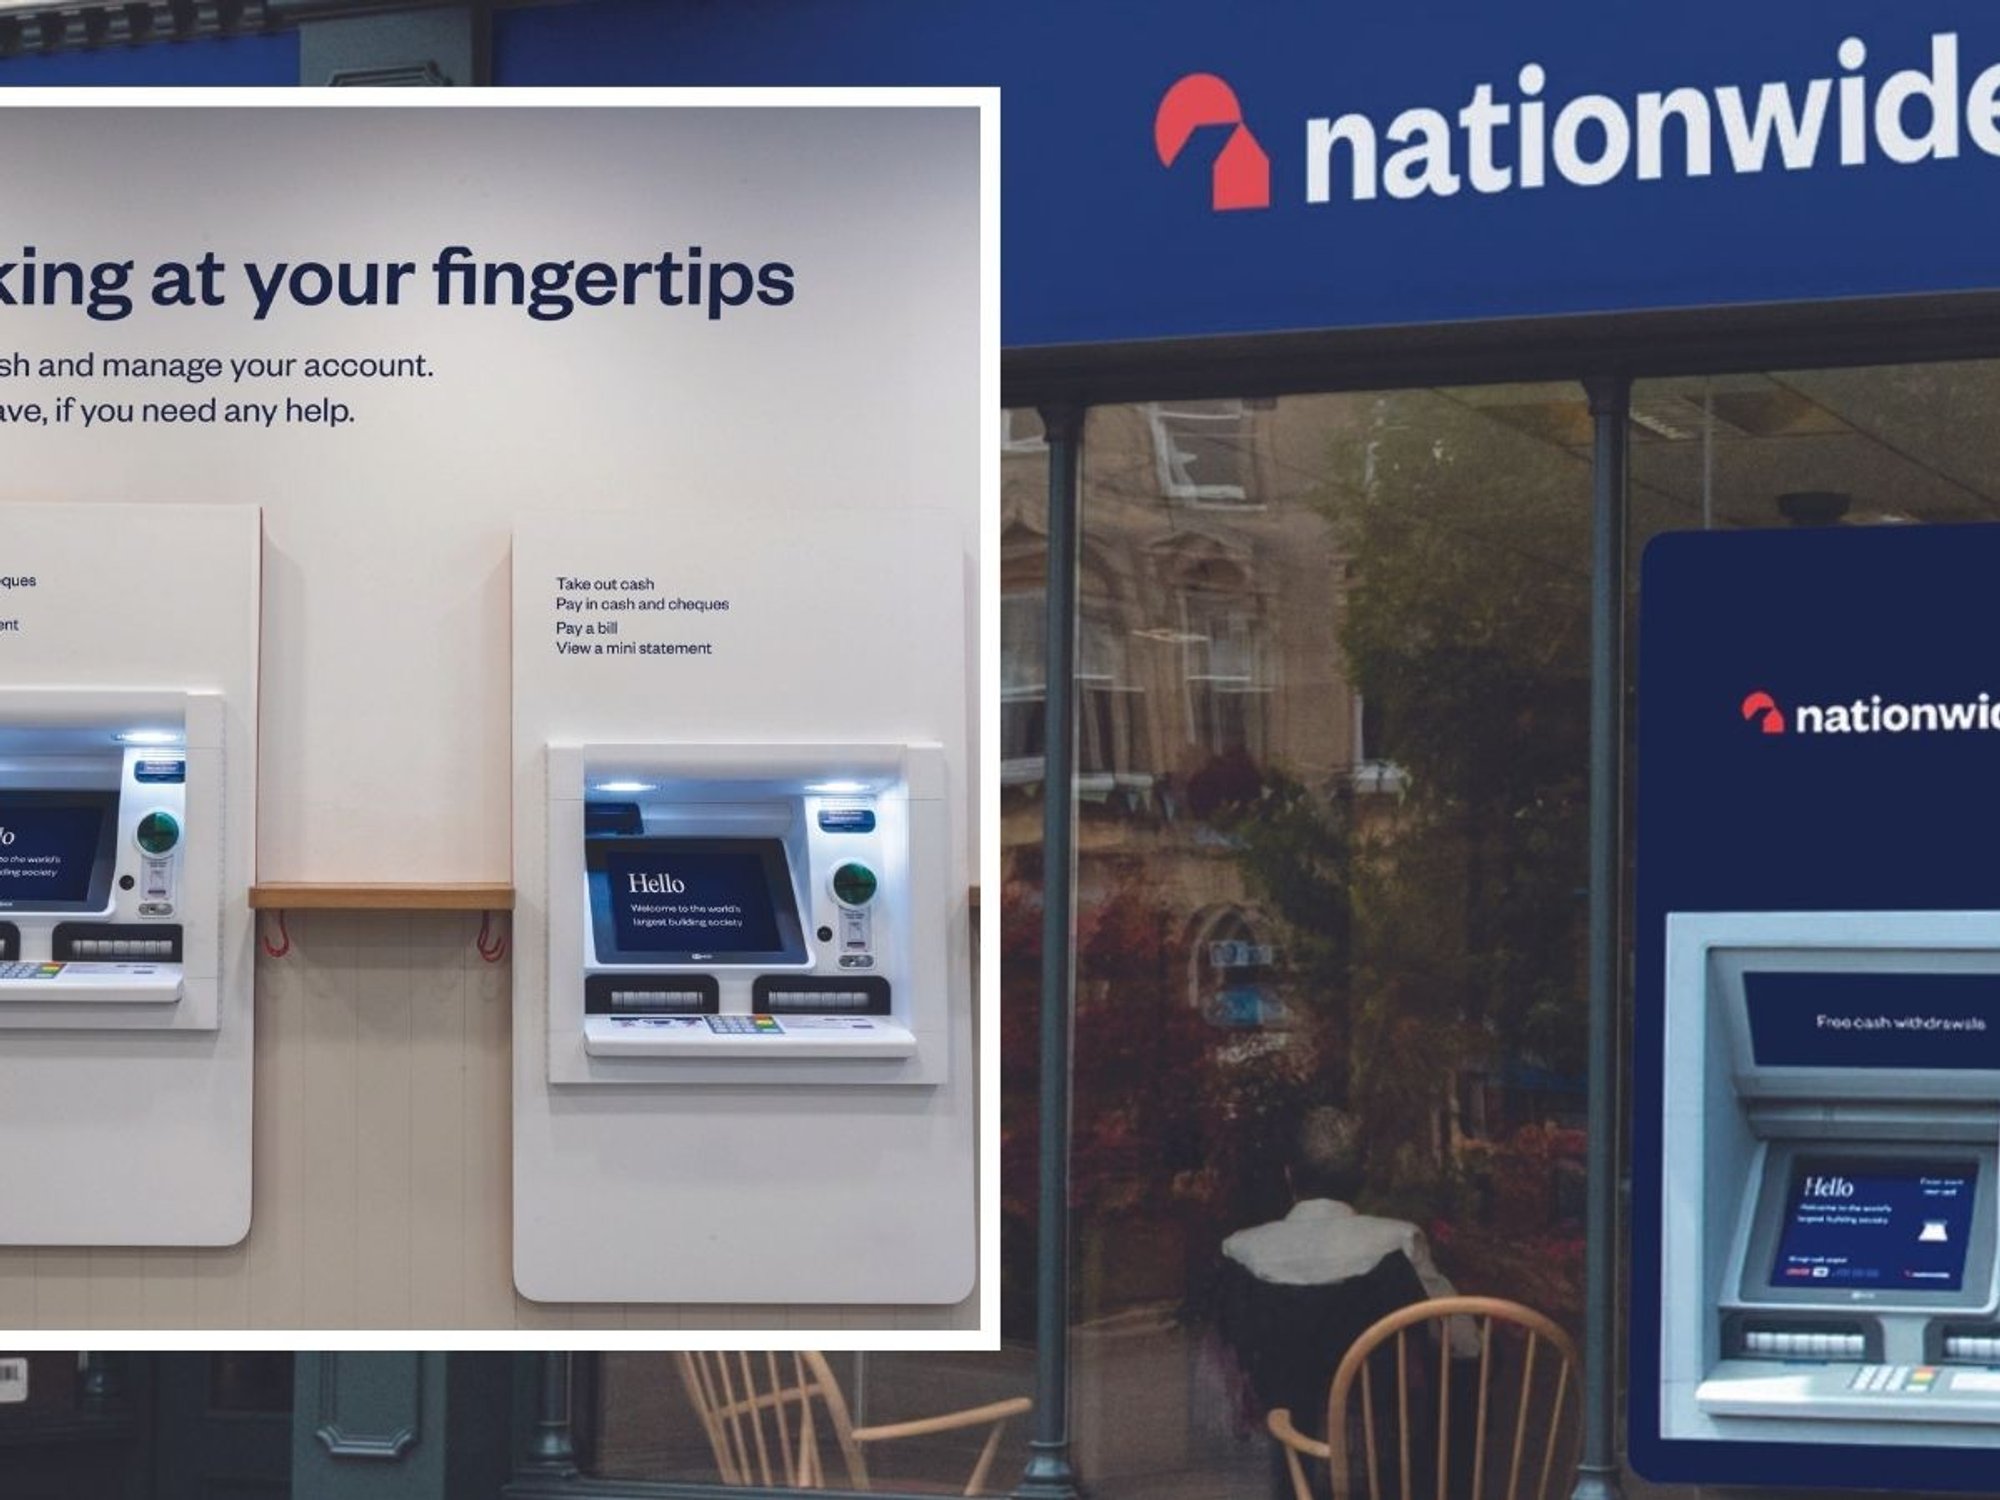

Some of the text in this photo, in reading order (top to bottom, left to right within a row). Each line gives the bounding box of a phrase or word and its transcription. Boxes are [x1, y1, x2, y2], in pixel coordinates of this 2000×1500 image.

[151, 252, 226, 306] at
[244, 261, 415, 320] your
[433, 246, 795, 321] fingertips
[38, 352, 94, 377] and
[103, 358, 223, 382] manage
[231, 358, 297, 382] your
[304, 355, 434, 378] account.
[56, 397, 76, 422] if
[81, 403, 134, 427] you
[142, 398, 216, 422] need
[224, 403, 278, 427] any
[286, 398, 354, 427] help.
[556, 577, 655, 591] Take out cash
[556, 597, 730, 613] Pay in cash and cheques
[556, 621, 618, 637] Pay a bill
[556, 642, 712, 655] View a mini statement
[628, 873, 685, 893] Hello
[631, 904, 677, 912] Welcome
[633, 918, 742, 927] largest building society
[1816, 1014, 1851, 1029] Free
[1853, 1015, 1892, 1029] cash
[1804, 1177, 1854, 1197] Hello
